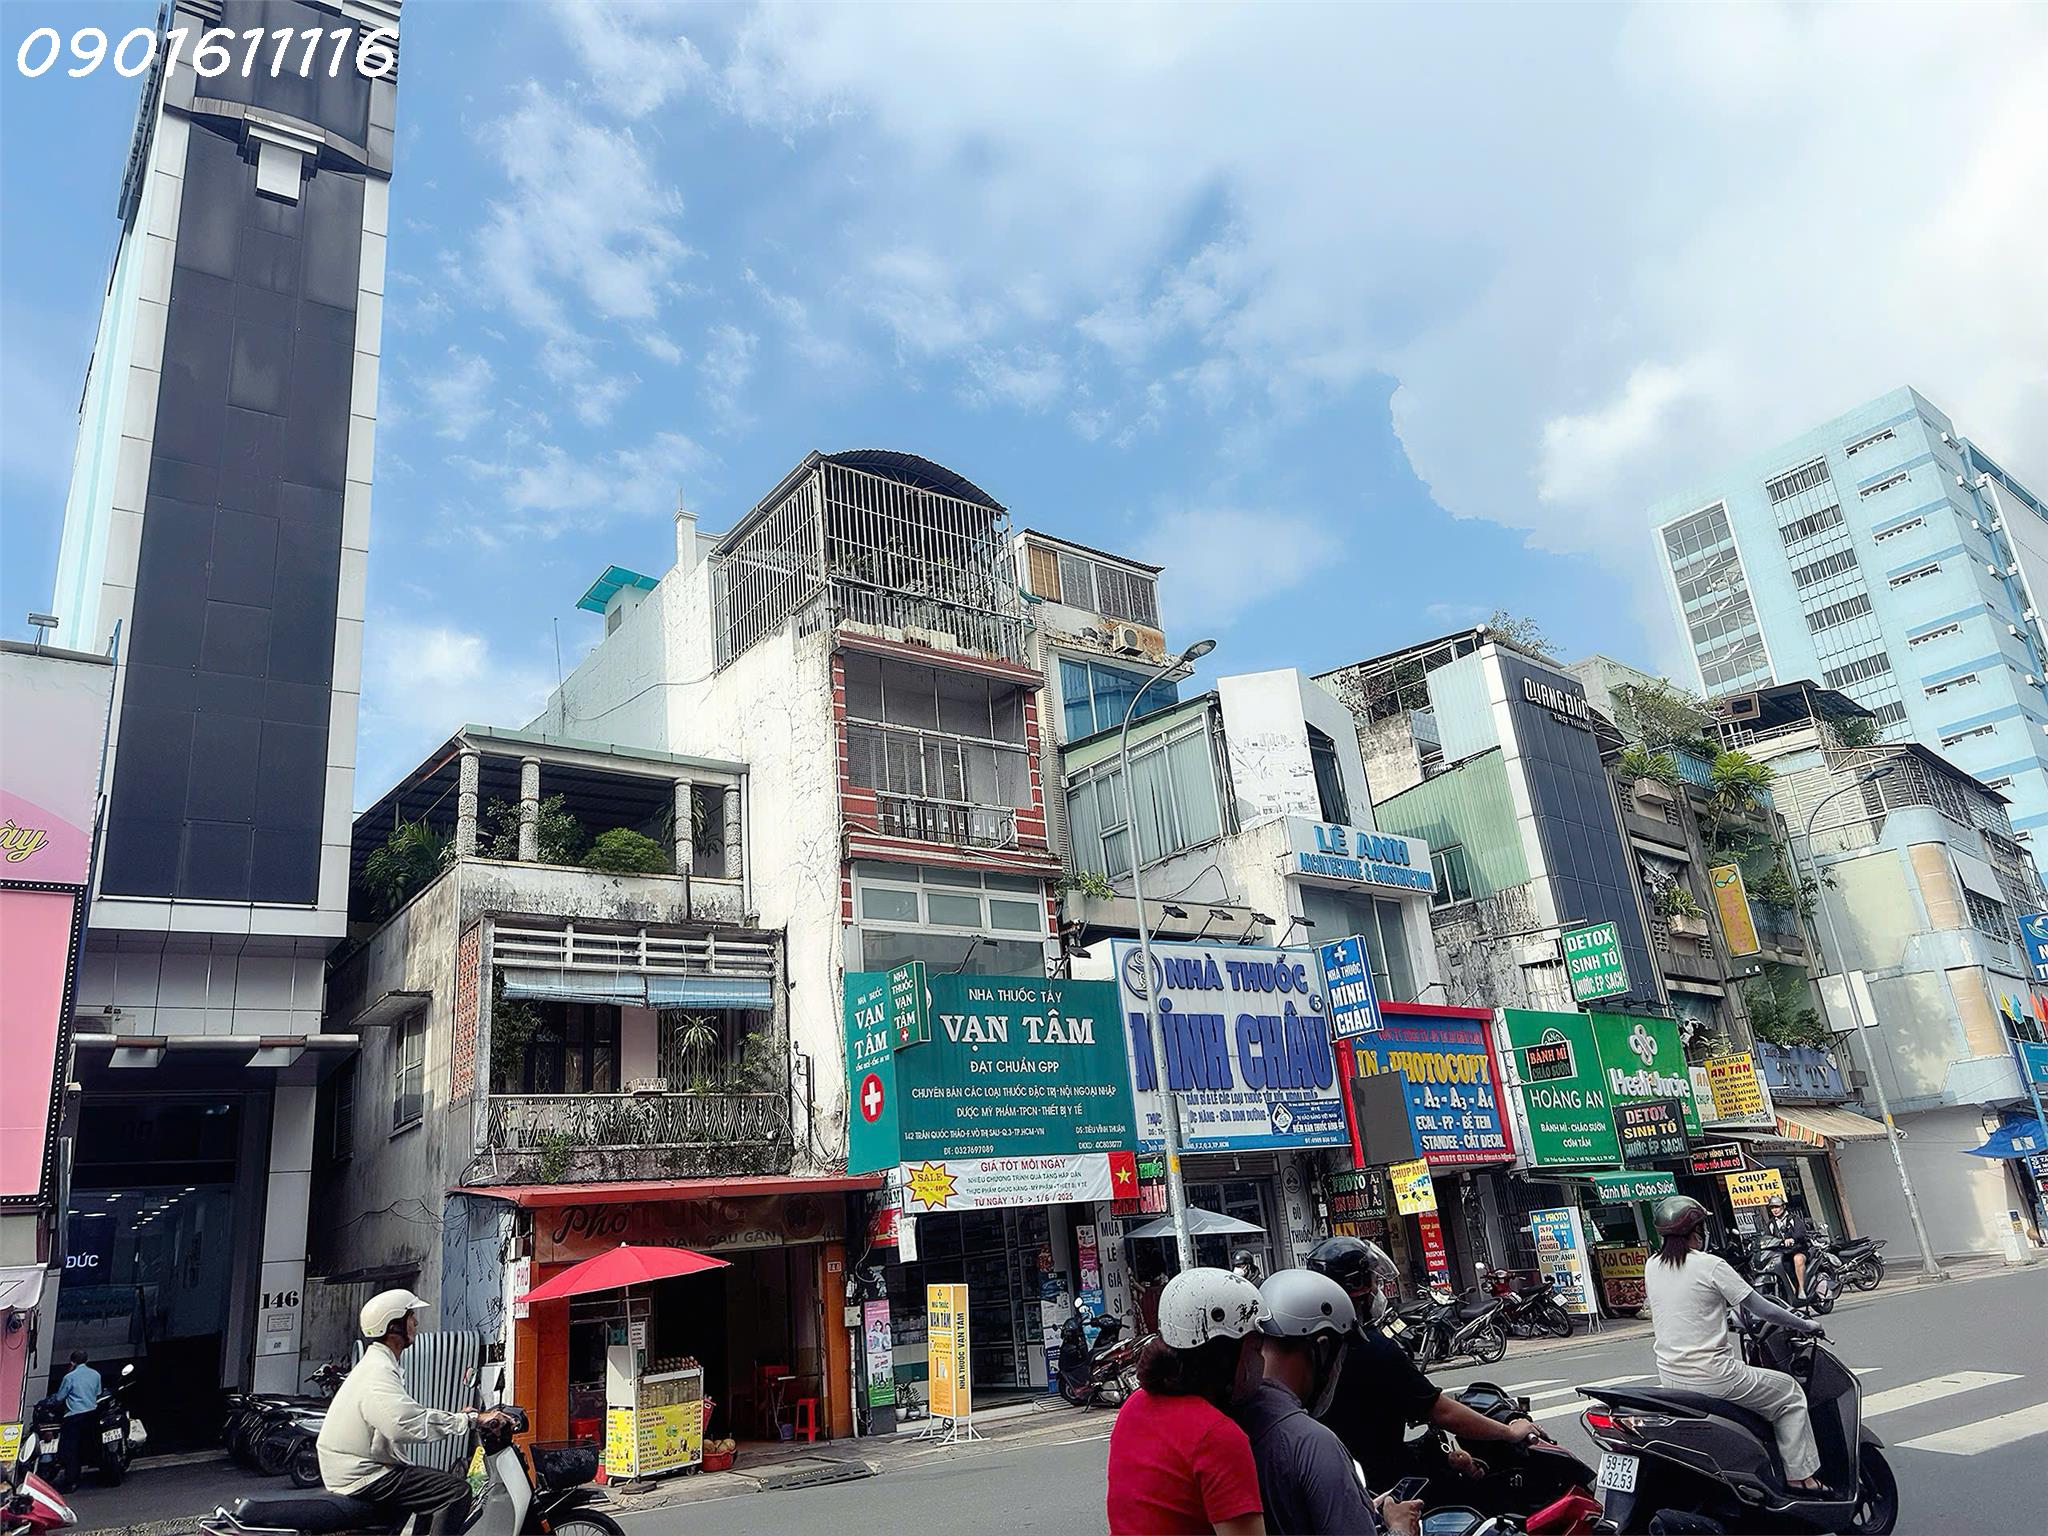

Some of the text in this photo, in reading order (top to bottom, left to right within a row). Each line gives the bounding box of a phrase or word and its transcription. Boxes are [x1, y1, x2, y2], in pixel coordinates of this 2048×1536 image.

[1314, 825, 1410, 866] LÊ ANH
[1299, 852, 1434, 891] ARCHITECTURE & CONSTRUCTION
[1566, 928, 1614, 952] DETOX
[1571, 945, 1618, 974] SINH TỐ
[1164, 953, 1309, 994] NHÀ THUỐC
[1605, 971, 1625, 993] SẠCH
[998, 987, 1036, 1002] THUỐC
[854, 1002, 886, 1031] VẠN
[894, 1010, 916, 1030] TÂM
[1336, 1005, 1372, 1034] CHÂU
[940, 1009, 1095, 1052] VẠN TÂM
[854, 1030, 889, 1060] TÂM
[1236, 1000, 1334, 1090] CHÂU
[1530, 1044, 1568, 1065] BÁNH MÌ
[970, 1056, 1059, 1075] ĐẠT CHUẨN GPP
[1389, 1050, 1490, 1085] PHOTOCOPY
[1711, 1067, 1726, 1078] AN
[984, 1087, 1001, 1098] LOẠI
[1002, 1084, 1027, 1096] THUỐC
[1530, 1086, 1604, 1109] HOÀNG AN
[1625, 1105, 1669, 1125] DETOX
[1623, 1119, 1677, 1139] SINH TỐ
[1422, 1135, 1459, 1150] STANDEE
[1481, 1134, 1506, 1149] DECAL
[981, 1160, 998, 1172] GIÁ
[917, 1173, 943, 1182] SALE
[1732, 1179, 1779, 1194] ẢNH THẺ
[1738, 1173, 1768, 1183] CHỤP
[1635, 1182, 1657, 1196] Cháo
[1101, 1221, 1120, 1237] MUA
[66, 1252, 98, 1268] ĐỨC
[1108, 1269, 1122, 1288] GIÁ
[261, 1290, 299, 1310] 146
[1606, 1455, 1633, 1473] 59-F2
